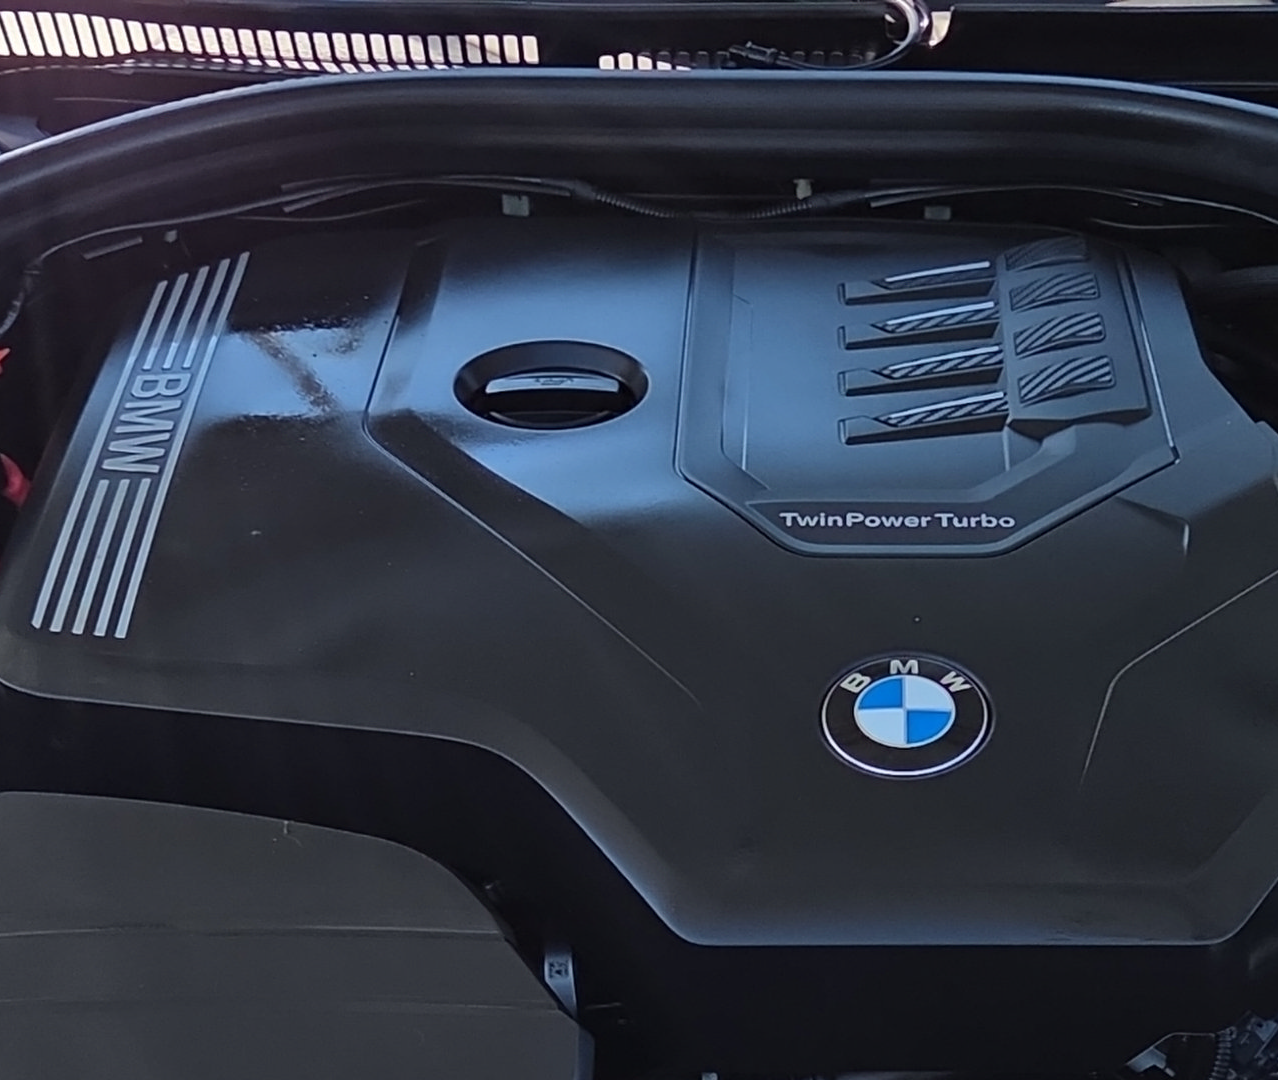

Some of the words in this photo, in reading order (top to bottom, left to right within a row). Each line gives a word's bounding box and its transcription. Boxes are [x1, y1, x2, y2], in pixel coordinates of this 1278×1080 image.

[101, 372, 192, 474] BMW
[934, 513, 1016, 528] Turbo
[840, 659, 972, 693] BMW
